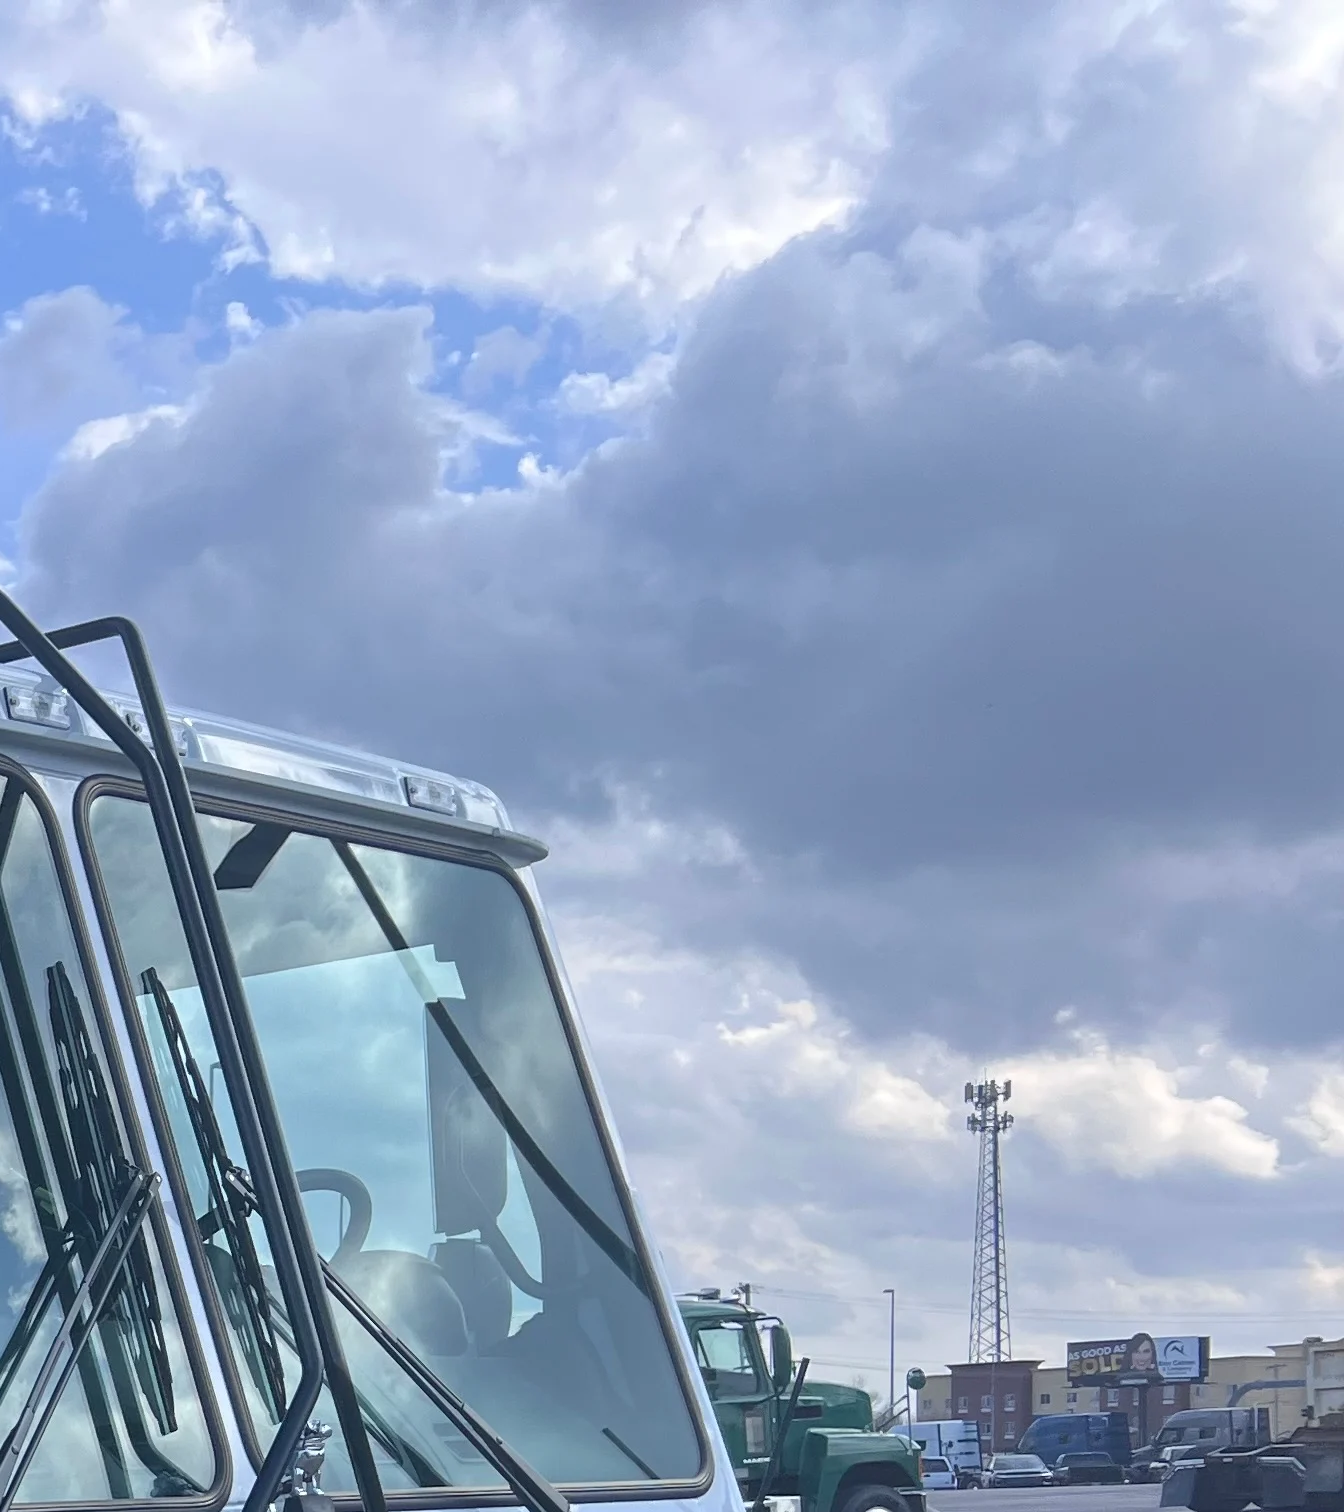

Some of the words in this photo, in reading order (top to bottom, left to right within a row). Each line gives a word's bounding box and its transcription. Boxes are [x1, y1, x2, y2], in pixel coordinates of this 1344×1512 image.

[1067, 1351, 1080, 1361] AS
[1081, 1345, 1112, 1358] GOOD
[1113, 1343, 1127, 1354] AS
